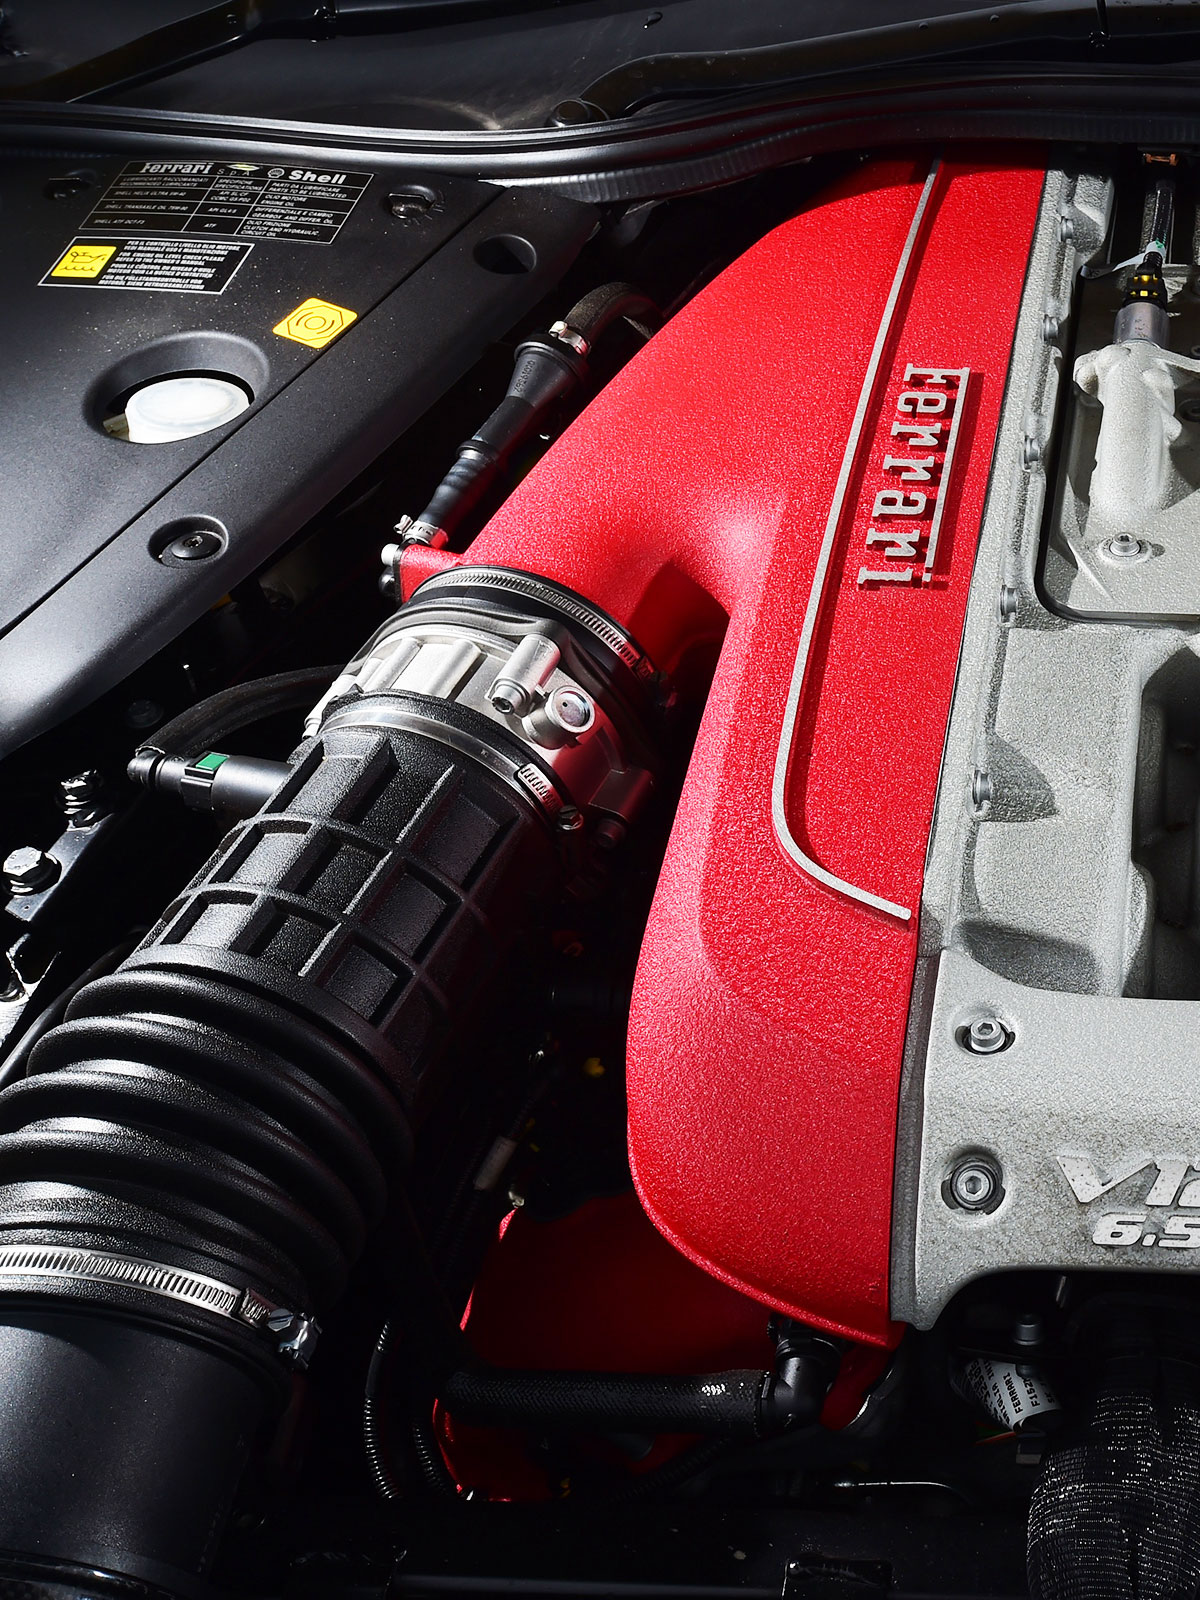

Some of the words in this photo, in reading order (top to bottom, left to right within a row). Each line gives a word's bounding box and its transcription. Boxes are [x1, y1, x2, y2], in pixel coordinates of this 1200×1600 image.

[140, 162, 214, 174] Ferrari
[288, 169, 347, 185] Shell
[300, 185, 341, 193] LUBRIFICARE
[308, 190, 347, 199] LUBRICATED
[254, 207, 304, 215] DIFFERENZIALE
[282, 228, 320, 236] HYDRAULIC
[182, 248, 229, 256] MANUTENZIONE
[857, 363, 970, 585] Ferrari
[1003, 1372, 1023, 1414] FERRARI
